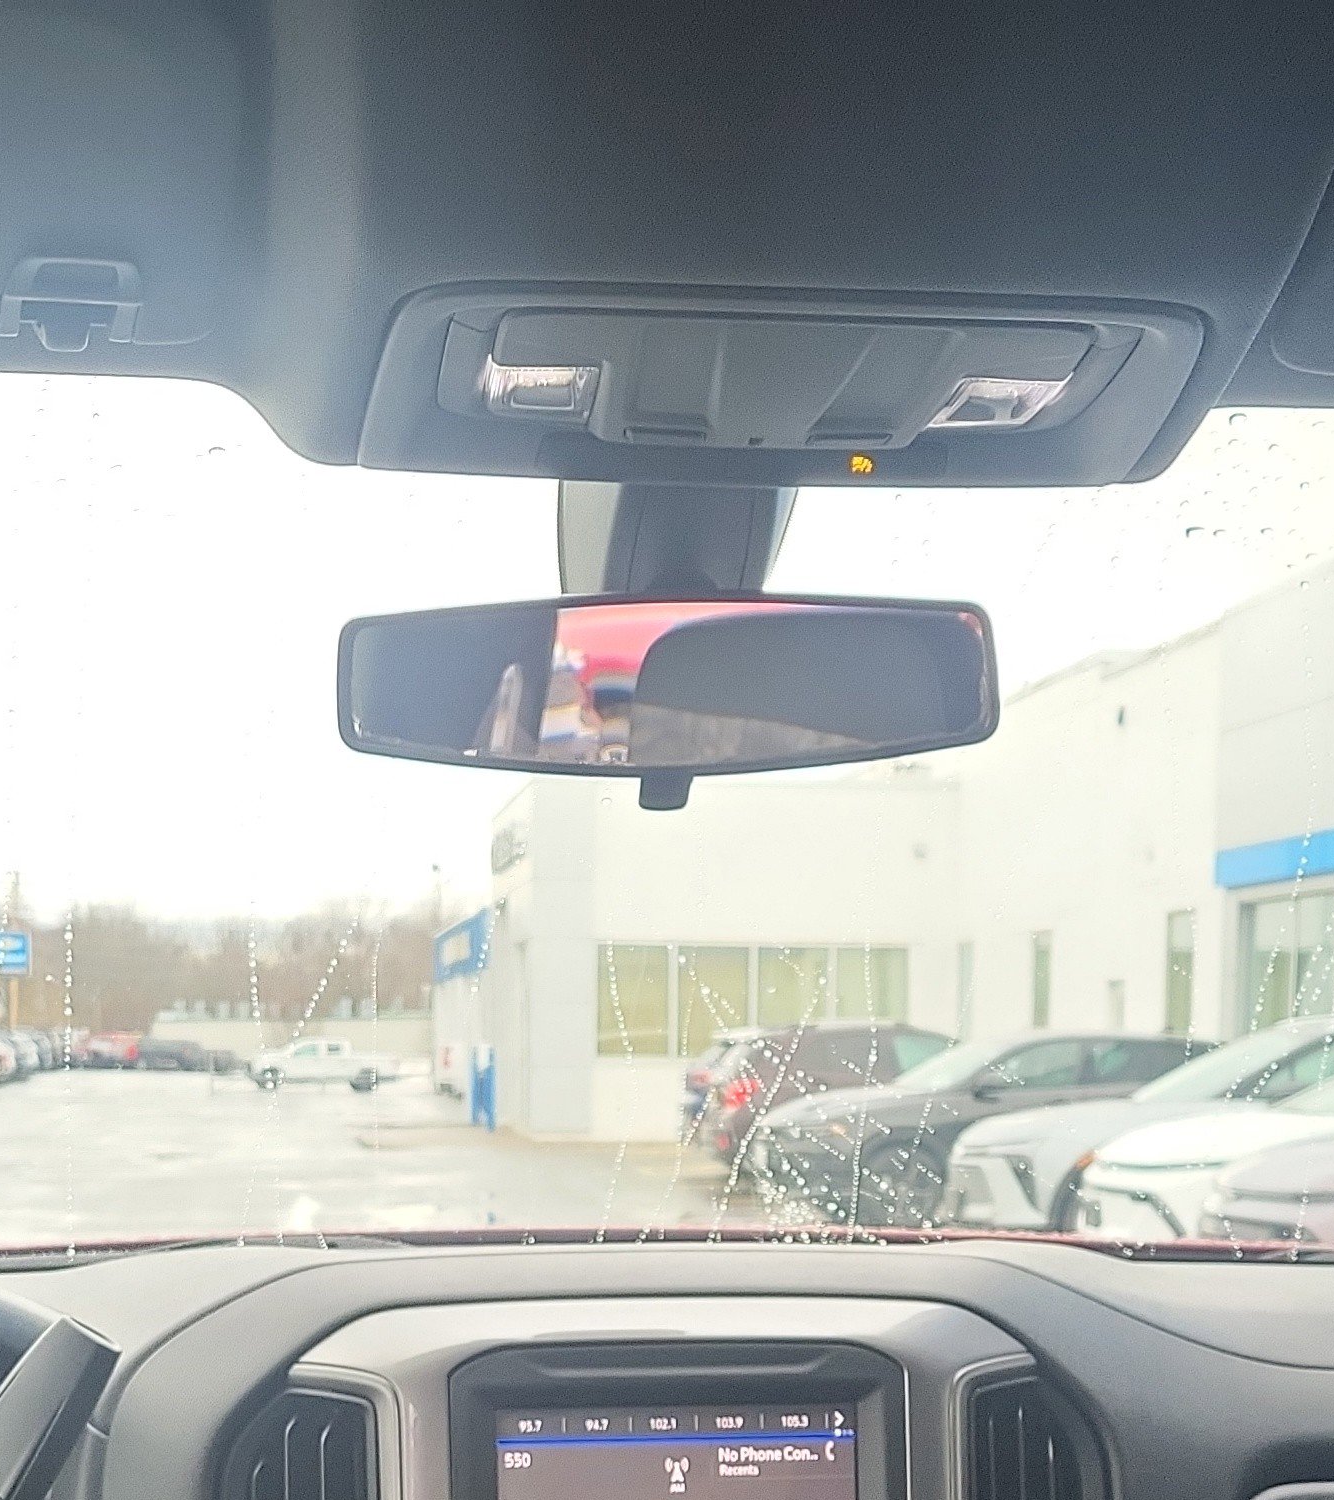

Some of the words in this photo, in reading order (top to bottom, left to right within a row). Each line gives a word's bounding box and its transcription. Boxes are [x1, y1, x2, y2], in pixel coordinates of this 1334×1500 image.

[504, 1453, 531, 1469] 550
[718, 1448, 739, 1463] No
[740, 1446, 782, 1463] Phone
[719, 1464, 759, 1477] Recents
